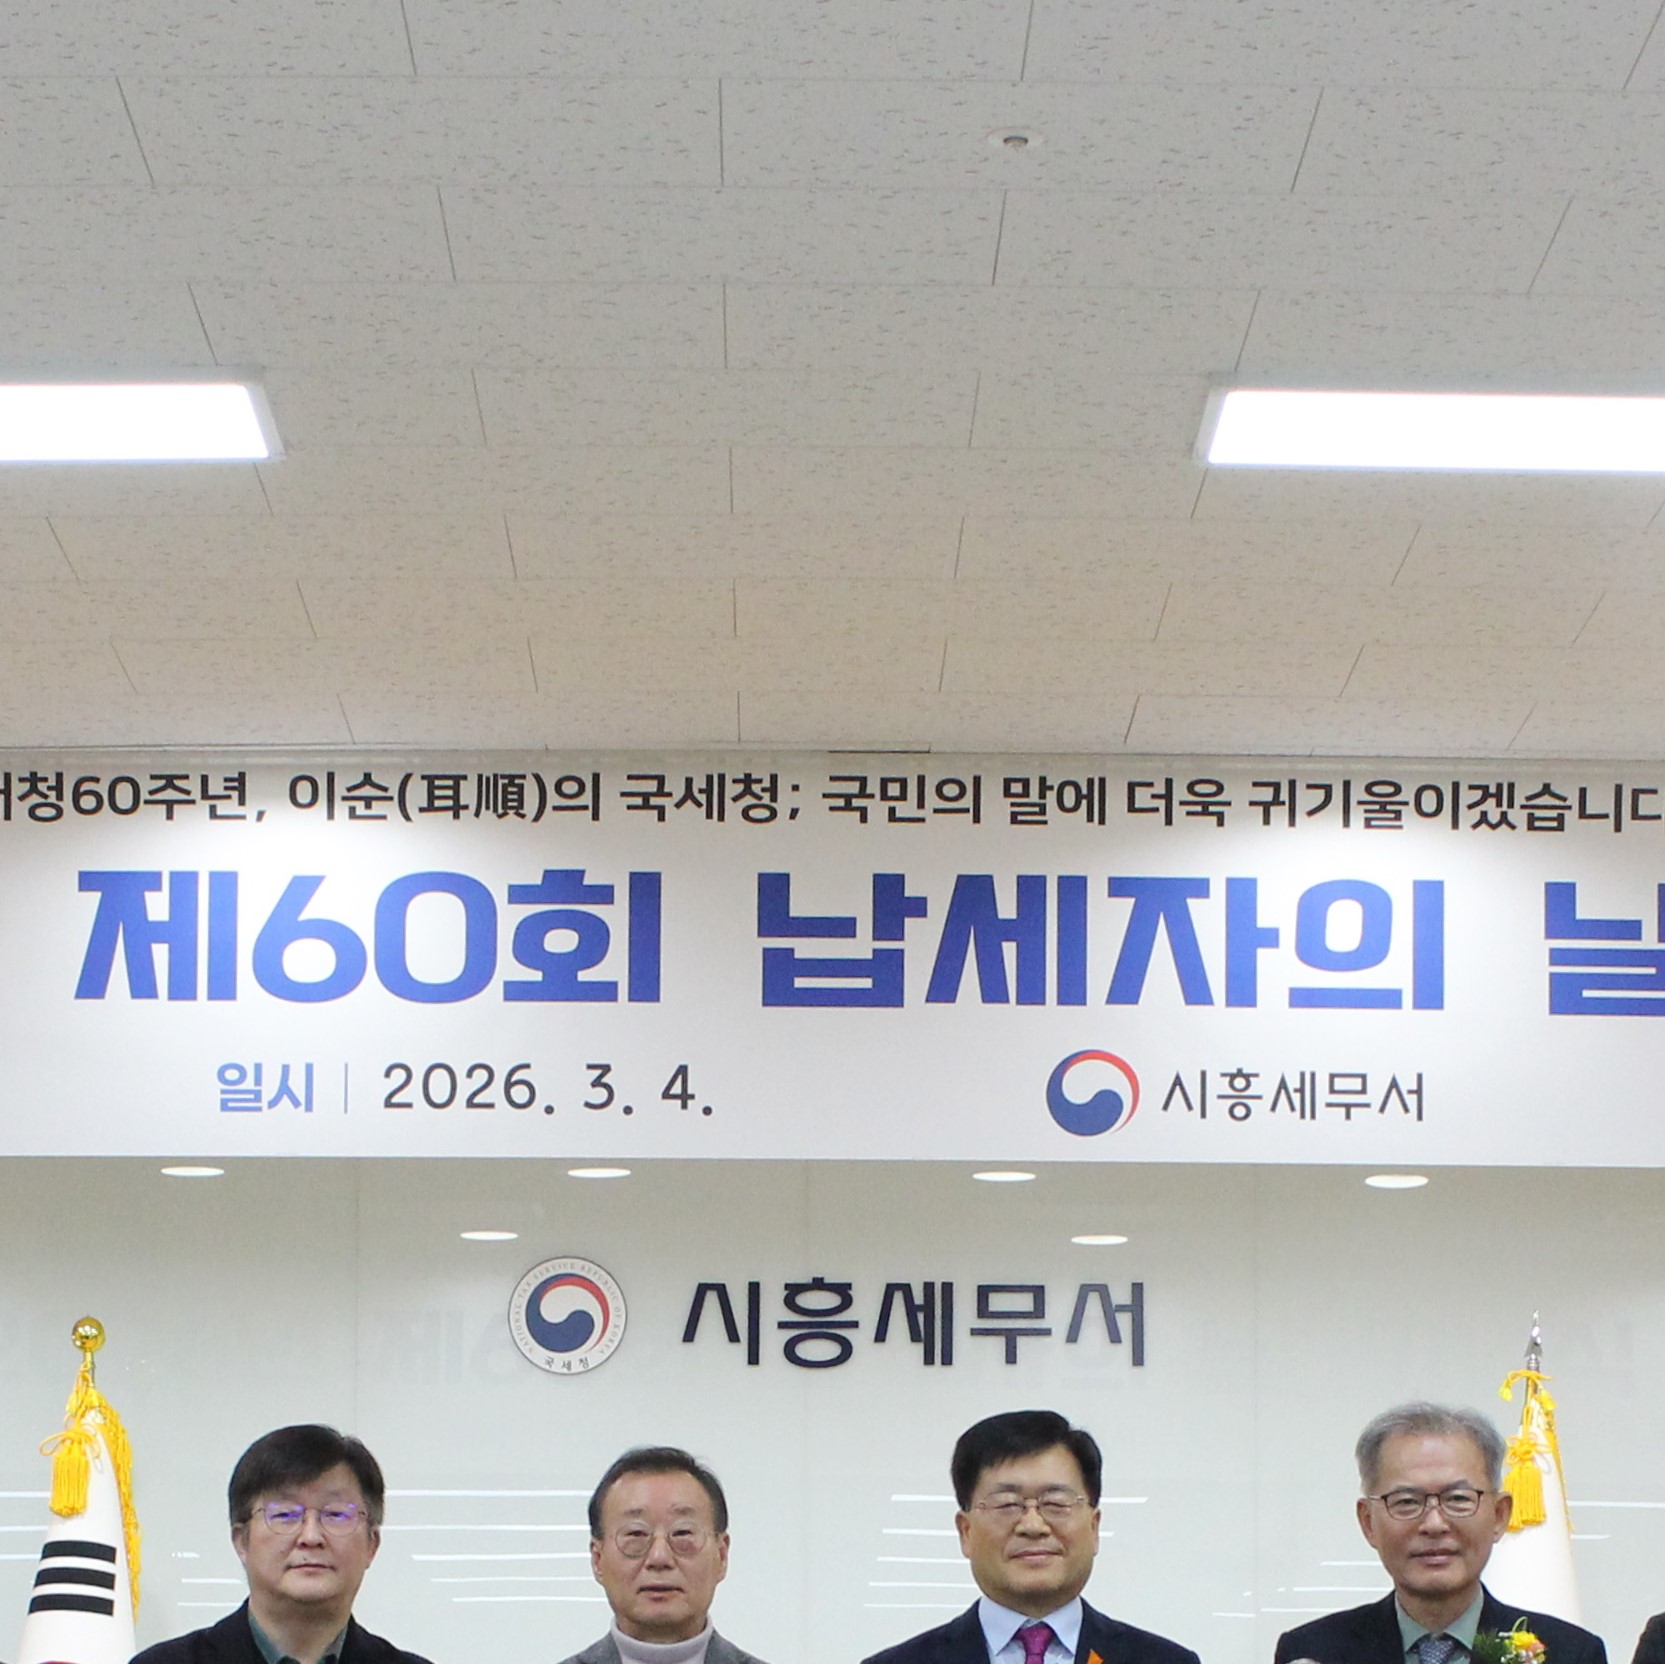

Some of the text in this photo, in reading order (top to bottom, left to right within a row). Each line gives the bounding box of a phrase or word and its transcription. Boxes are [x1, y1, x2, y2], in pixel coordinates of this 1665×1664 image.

[289, 771, 600, 823] 이순(耳順)의
[620, 773, 800, 824] 국세청;
[822, 774, 981, 824] 국민의
[1003, 776, 1106, 826] 말에
[1127, 777, 1232, 827] 더욱
[75, 868, 660, 1003] 제60회
[760, 872, 1445, 1009] 납세자의
[217, 1062, 712, 1116] 일시 2026. 3. 4.
[1162, 1068, 1423, 1121] 시흥세무서
[681, 1276, 1145, 1367] 시흥세무서
[544, 1355, 591, 1372] 국세청
